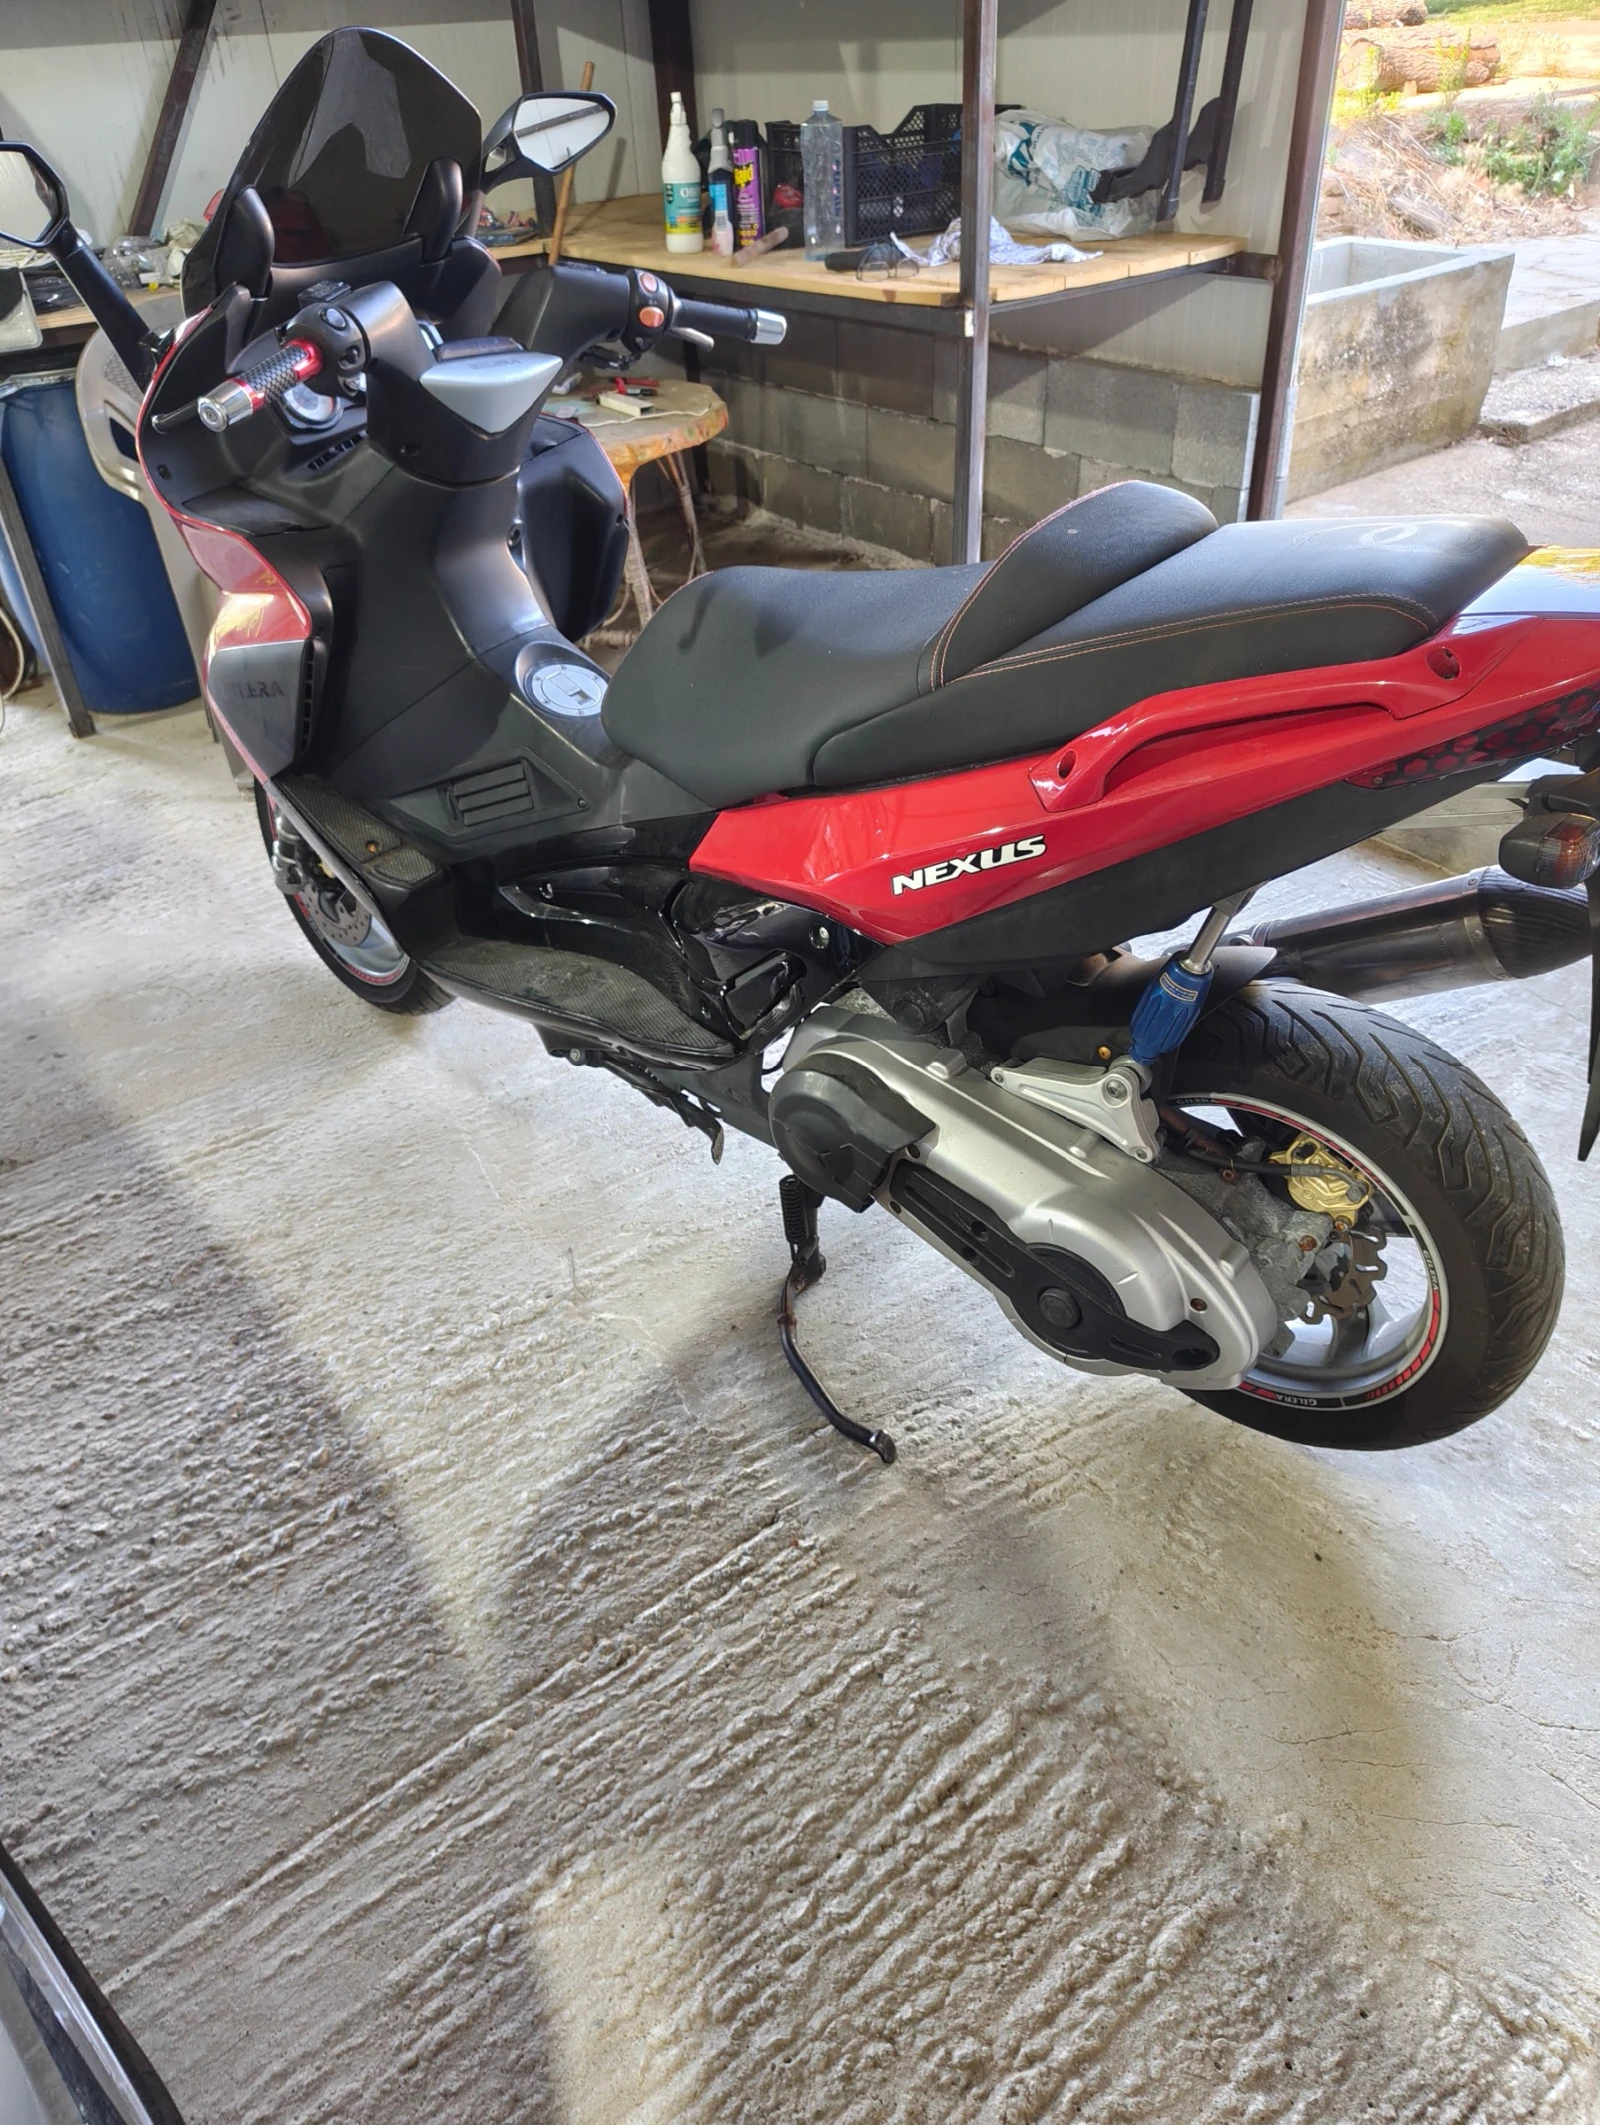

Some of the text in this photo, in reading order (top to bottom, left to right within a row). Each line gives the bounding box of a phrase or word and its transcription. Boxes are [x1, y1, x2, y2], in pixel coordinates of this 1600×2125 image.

[891, 834, 1047, 896] NEXUS
[1176, 1097, 1217, 1105] GILERA
[1423, 1249, 1439, 1290] GILERA
[1275, 1393, 1318, 1407] GILERA
